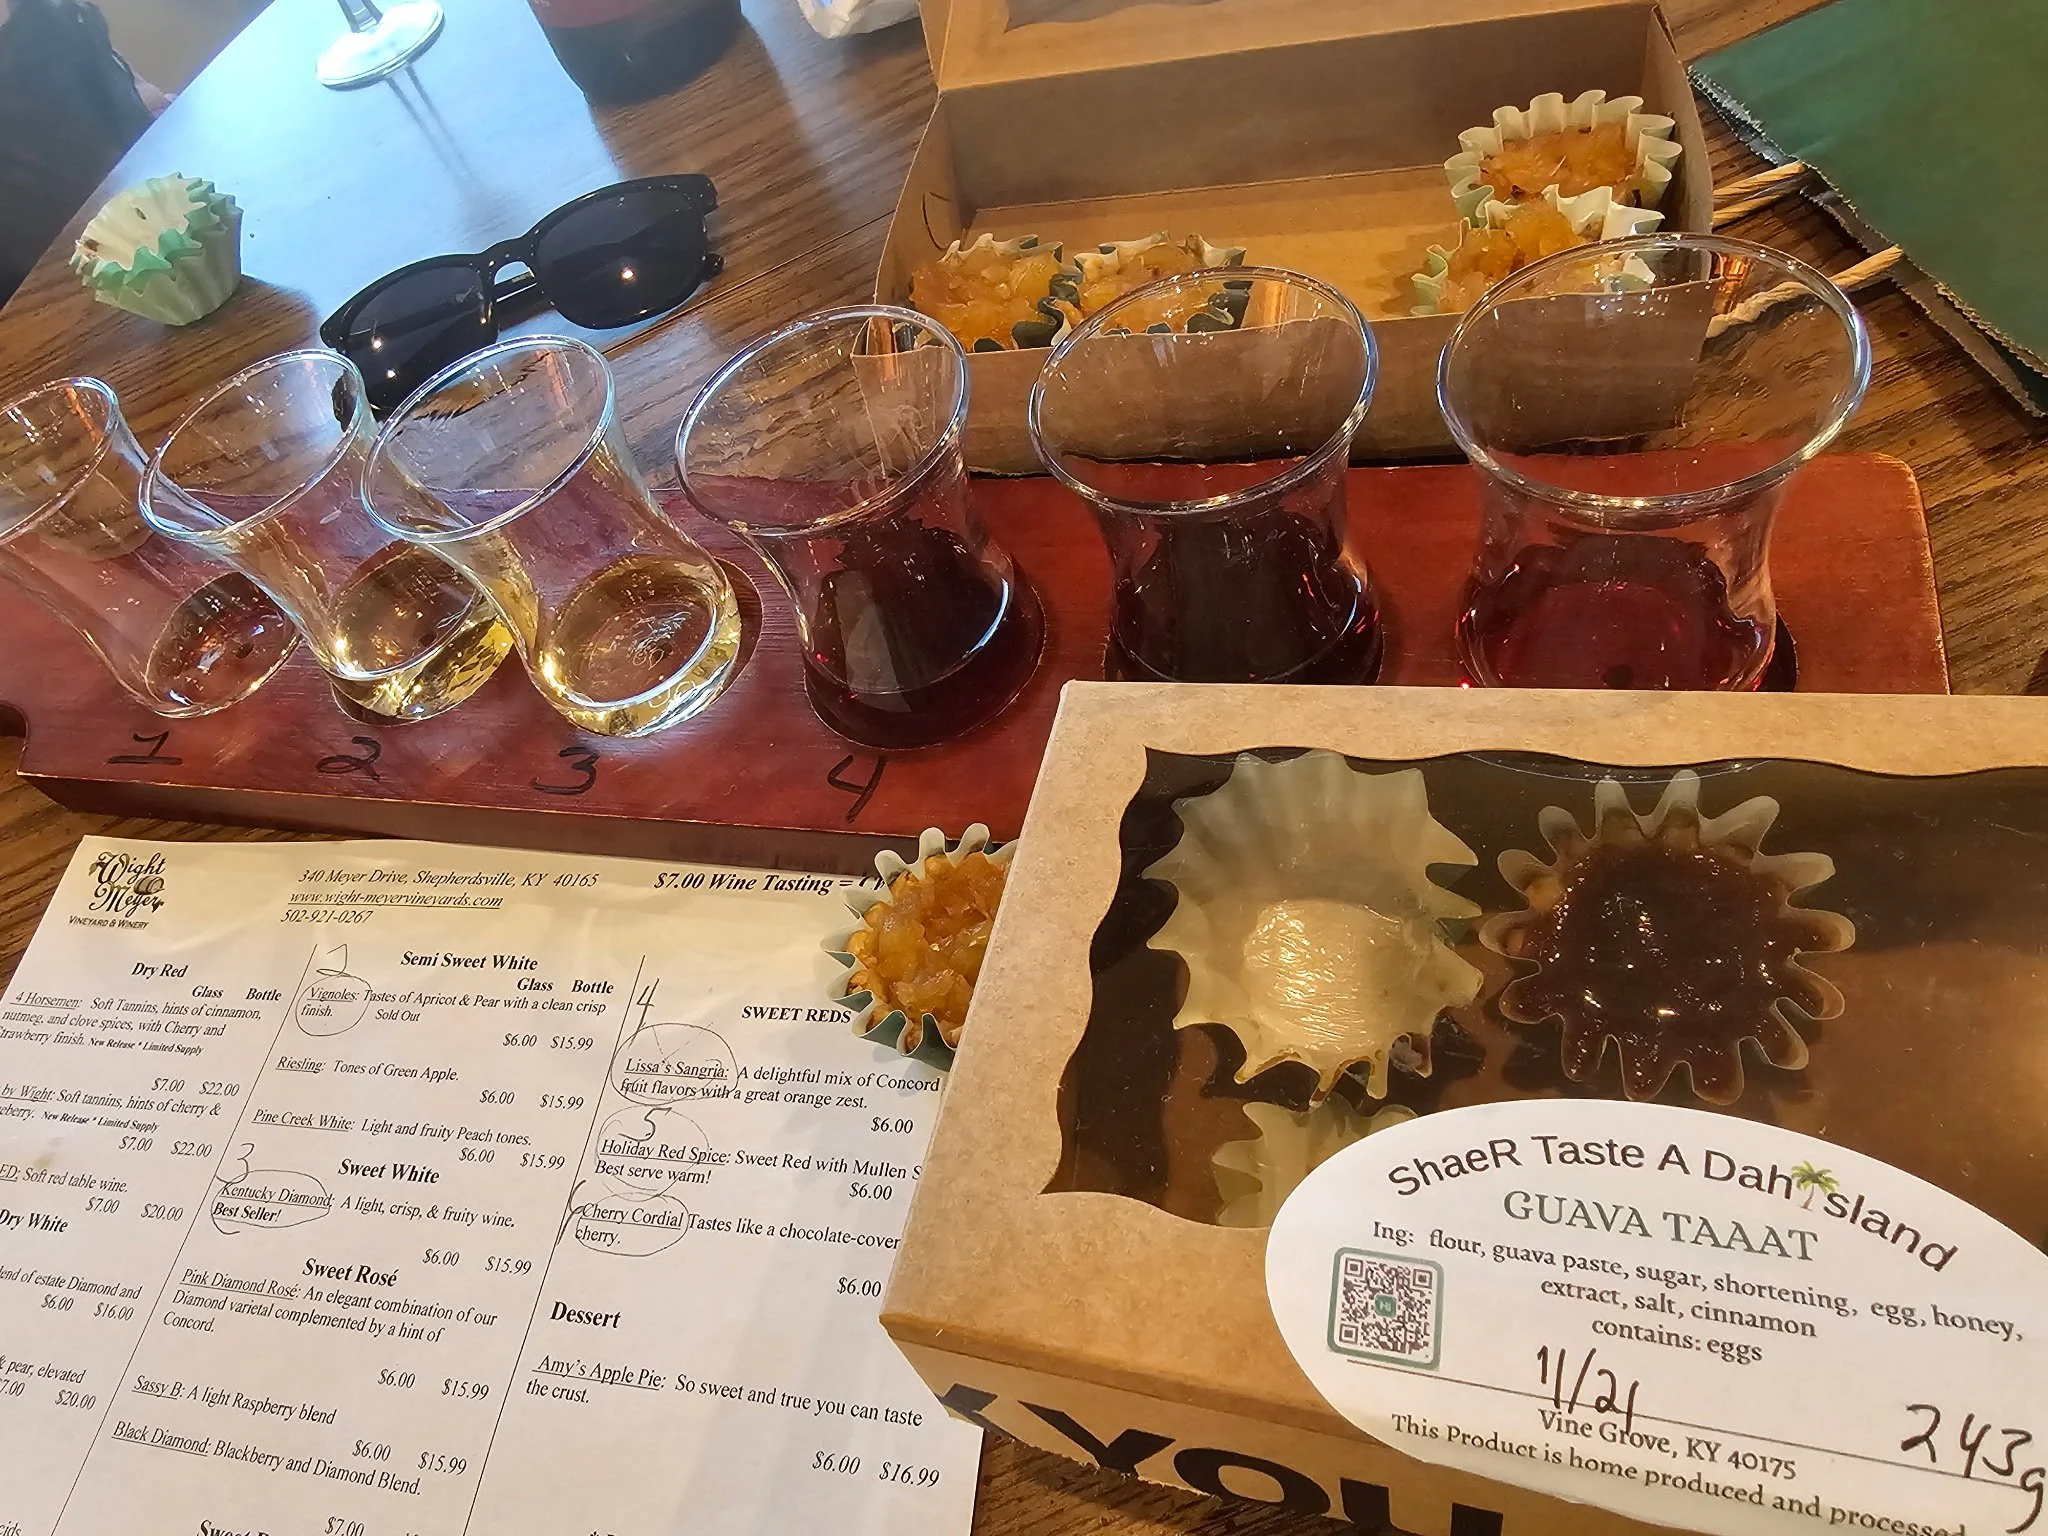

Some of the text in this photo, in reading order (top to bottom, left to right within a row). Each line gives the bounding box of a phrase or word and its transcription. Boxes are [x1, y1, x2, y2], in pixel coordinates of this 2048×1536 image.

[316, 734, 383, 782] 2
[531, 744, 601, 796] 3
[826, 754, 887, 823] 4
[298, 869, 599, 889] 340 Meyer Drive, Shepherdsville, KY 40165
[654, 873, 833, 896] $7.00 Wine Tasting
[288, 891, 503, 908] www.wight-meyervineyards.com
[280, 909, 373, 924] 502-921-0267
[131, 962, 188, 978] Dry Red
[400, 951, 539, 972] Semi Sweet White
[192, 986, 282, 1001] Glass Bottle
[517, 978, 614, 994] Glass Bottle
[90, 997, 261, 1021] Soft Tannins, hints cinnamon,
[375, 1009, 421, 1022] Sold Out
[413, 993, 606, 1016] Apricot Pear clean crisp
[632, 978, 660, 1035] 4
[741, 1006, 851, 1023] SWEET REDS
[100, 1017, 133, 1031] spices,
[164, 1021, 201, 1037] Cherry
[276, 1056, 459, 1083] Riesling: Green Apple.
[625, 1058, 941, 1093] Lissa's Sangria: delightful Concord
[198, 1081, 240, 1097] $22.00
[744, 1088, 868, 1109] great orange zest.
[252, 1108, 531, 1146] Pine Creek White: Light fruity Peach tones.
[617, 1107, 672, 1142] 5
[216, 1143, 255, 1184] 3
[338, 1158, 440, 1184] Sweet White
[519, 1152, 565, 1170] $15.99
[594, 1160, 712, 1185] Best warm!
[601, 1139, 906, 1180] Holiday Red Spice: Sweet Red Mullen
[1388, 1137, 1523, 1196] ShaeR
[1530, 1134, 1645, 1168] Taste
[1656, 1143, 1691, 1175] A
[1703, 1149, 1792, 1200] Dah
[849, 1182, 892, 1201] $6.00
[0, 1209, 68, 1234] Dry White
[213, 1202, 281, 1223] Best Seller!
[352, 1197, 515, 1229] light, crisp, fruity wine.
[1503, 1190, 1818, 1260] GUAVA TAAAT
[688, 1213, 732, 1232] Tastes
[780, 1223, 902, 1249] chocolate-cover
[302, 1258, 398, 1288] Sweet Rosé
[485, 1255, 532, 1275] $15.99
[1374, 1221, 2023, 1343] Ing: flour, guava paste, sugar, shortening, egg, honey,
[172, 1289, 367, 1336] Diamond varietal complemented
[326, 1289, 455, 1320] elegant combination
[550, 1300, 621, 1329] Dessert
[1540, 1280, 1817, 1338] extract, salt, cinnamon
[163, 1311, 214, 1332] Concord.
[1591, 1319, 1763, 1366] contains: eggs
[133, 1374, 297, 1422] Sassy light Raspberry
[538, 1354, 923, 1427] Amy's Apple Pie: sweet taste
[113, 1420, 149, 1442] Black
[213, 1440, 283, 1473] Blackberry
[313, 1459, 376, 1486] Diamond
[377, 1472, 421, 1496] Blend.
[1537, 1408, 1797, 1481] Vine Grove, KY 40175
[812, 1450, 861, 1476] $6.00
[1391, 1413, 1439, 1439] This
[1446, 1424, 1537, 1460] Product
[1544, 1443, 1562, 1465] is
[1569, 1446, 1637, 1480] home
[1644, 1468, 1764, 1506] produced
[1772, 1495, 1820, 1518] and
